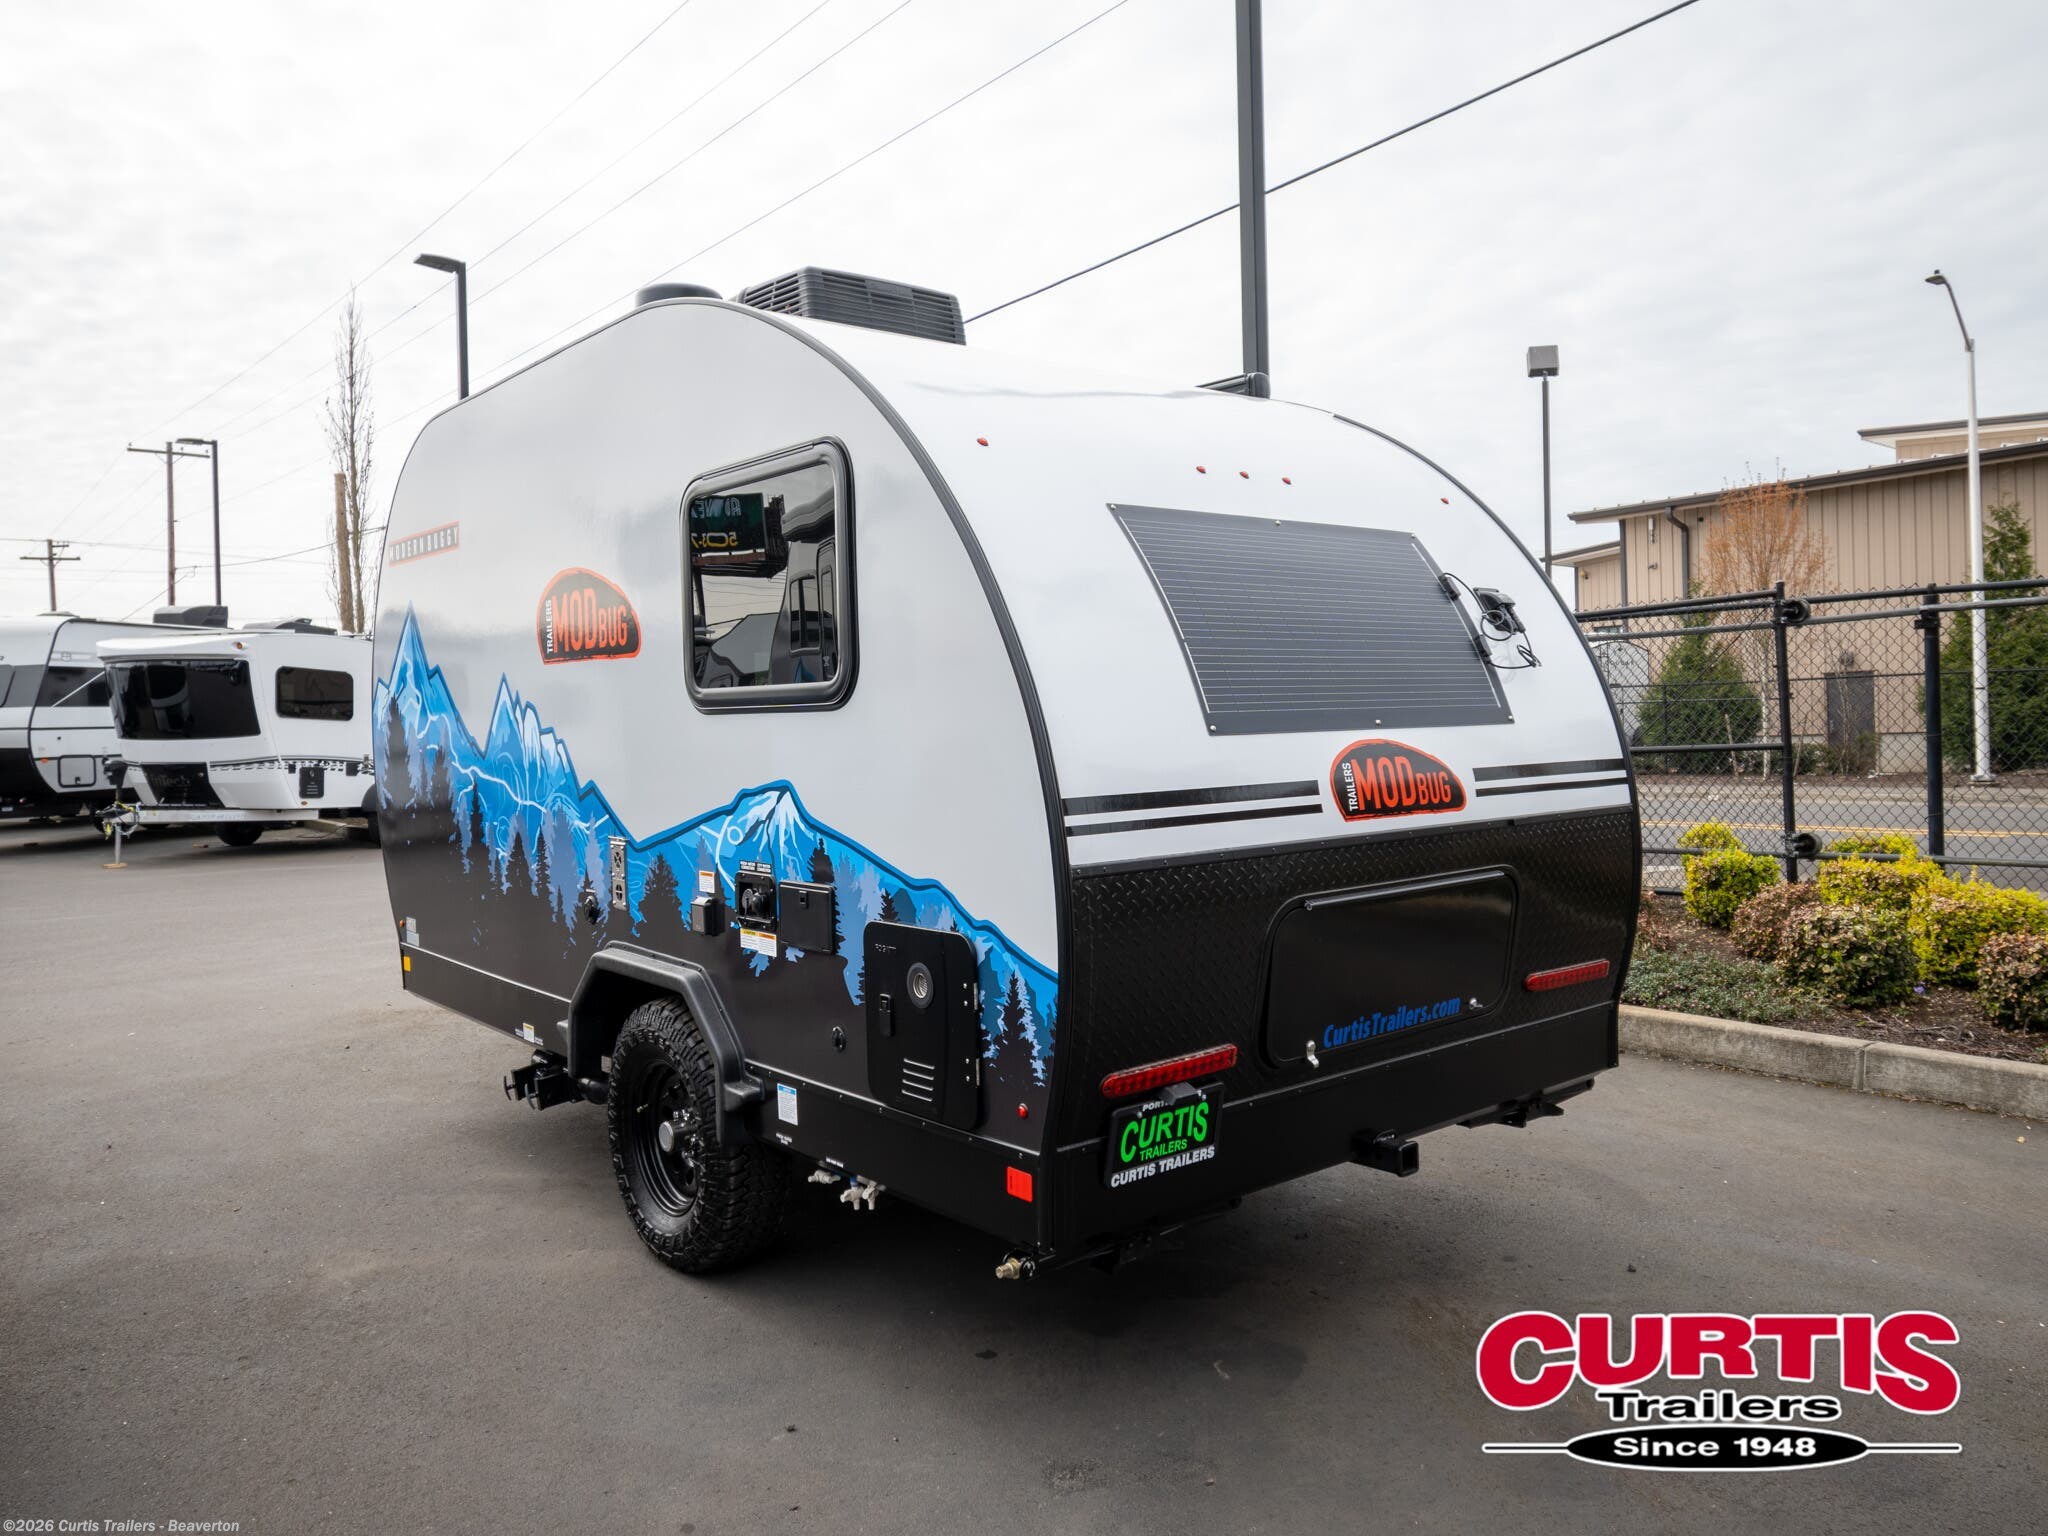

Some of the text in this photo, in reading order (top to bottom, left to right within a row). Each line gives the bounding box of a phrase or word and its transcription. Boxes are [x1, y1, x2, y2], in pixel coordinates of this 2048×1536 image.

[427, 527, 458, 552] BUGGY
[545, 599, 553, 654] TRAILERS
[1342, 762, 1358, 812] TRAILERS
[1322, 997, 1462, 1048] CurtisTrailers.com
[1120, 1101, 1209, 1163] CURTIS
[1139, 1138, 1188, 1162] TRAILERS
[1110, 1145, 1216, 1188] CURTIS TRAILERS
